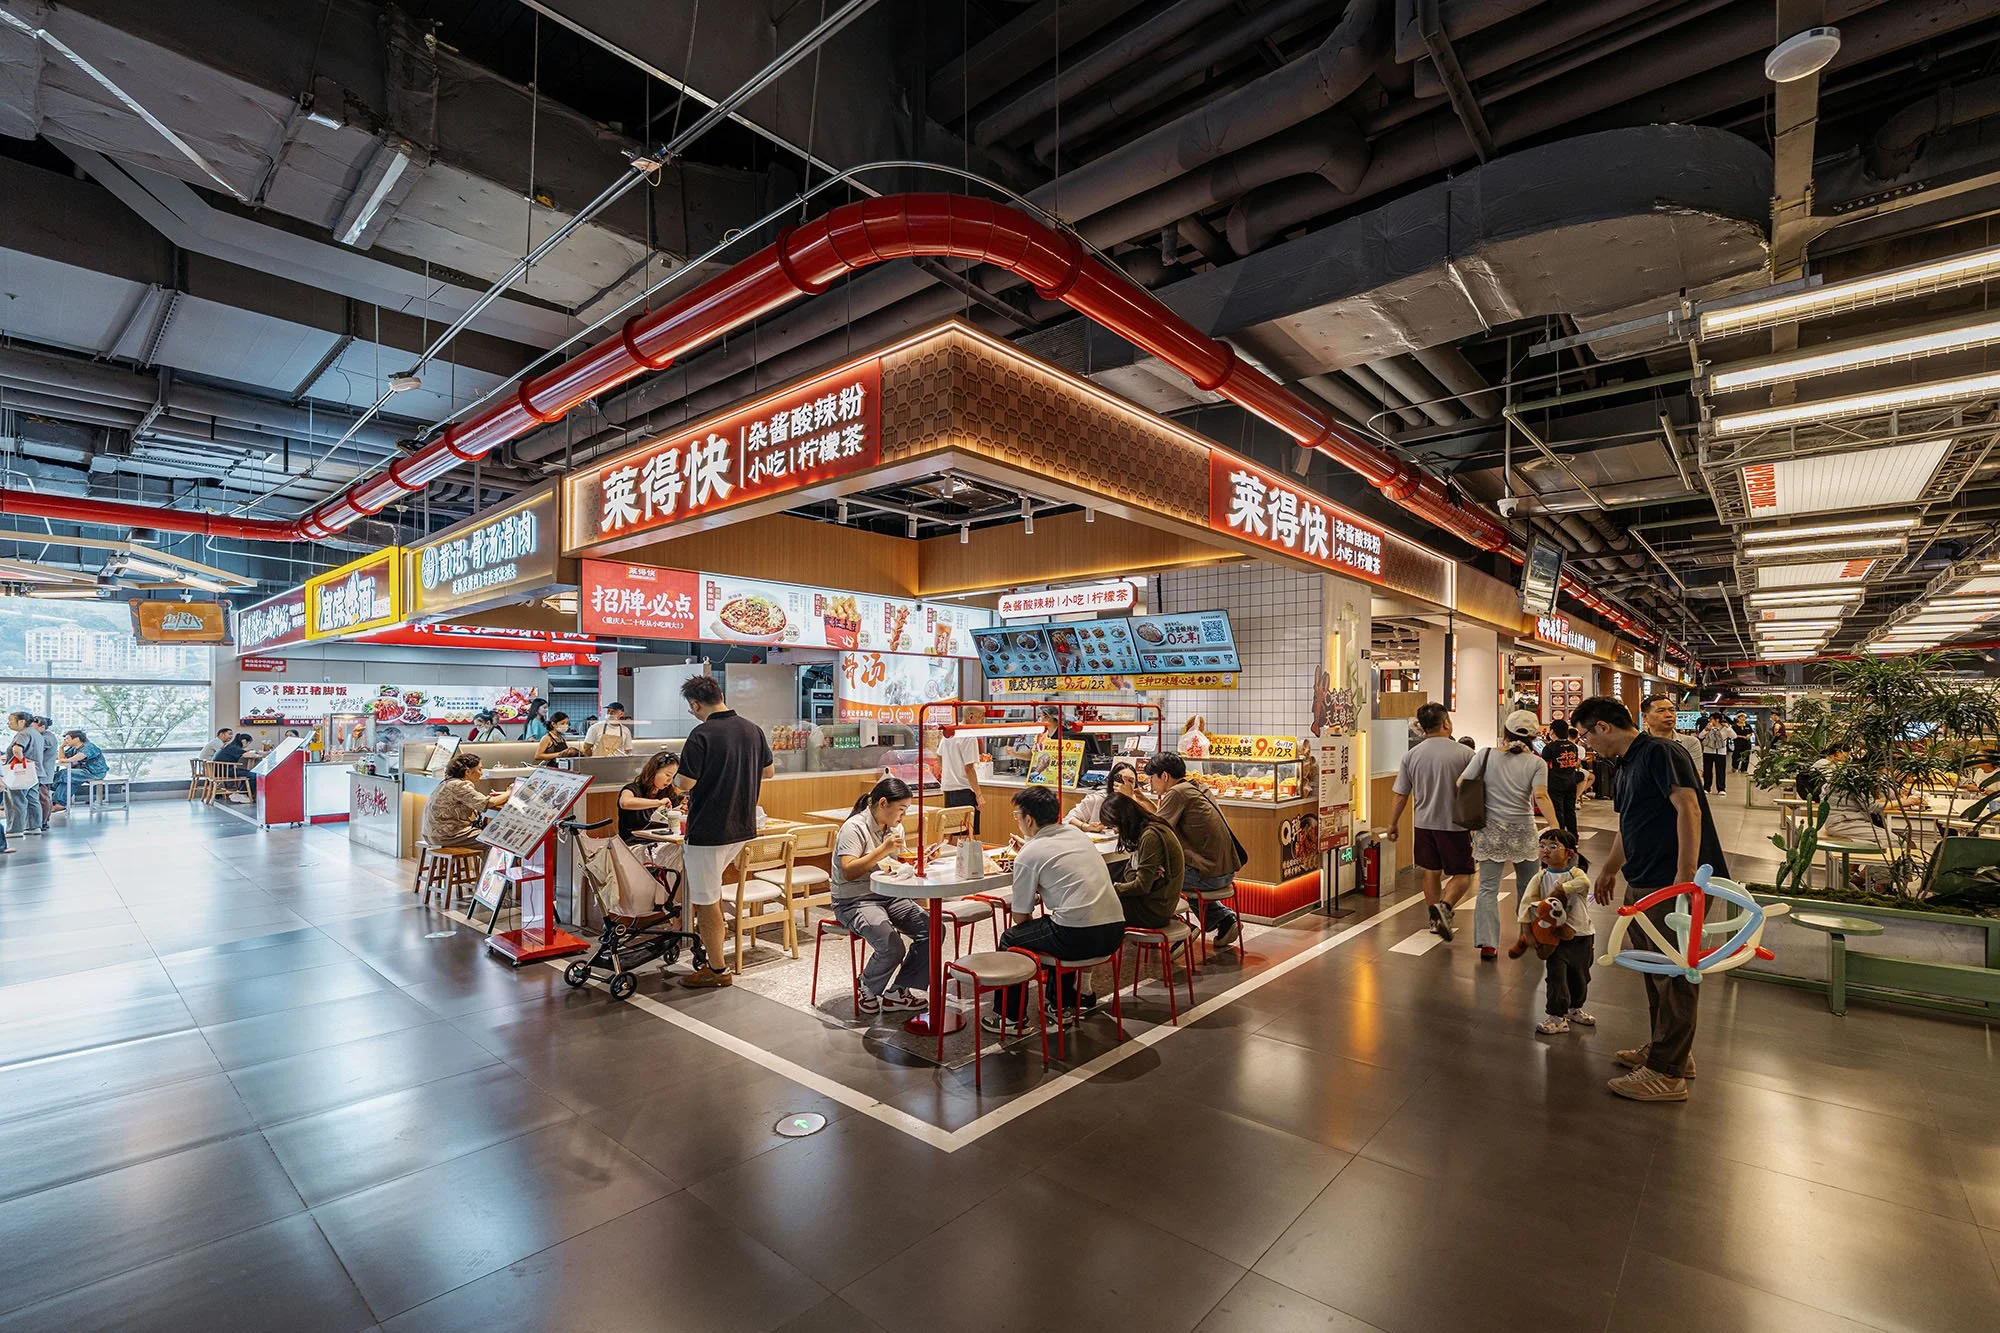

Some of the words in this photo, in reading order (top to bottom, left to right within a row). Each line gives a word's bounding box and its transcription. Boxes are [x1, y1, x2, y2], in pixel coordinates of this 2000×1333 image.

[748, 382, 865, 449] 杂酱酸辣粉
[747, 450, 786, 485] 小吃
[798, 423, 864, 471] 柠檬茶
[600, 434, 735, 533] 莱得快
[1226, 470, 1329, 560] 莱得快
[1335, 519, 1381, 555] 杂酱酸辣粉
[1335, 543, 1354, 566] 小吃
[591, 584, 695, 620] 招牌必点
[1002, 596, 1055, 613] 杂酱酸辣粉
[1062, 594, 1085, 607] 小吃
[1091, 589, 1129, 605] 柠檬茶
[841, 653, 886, 689] 骨汤
[282, 685, 348, 696] 隆江猪脚饭
